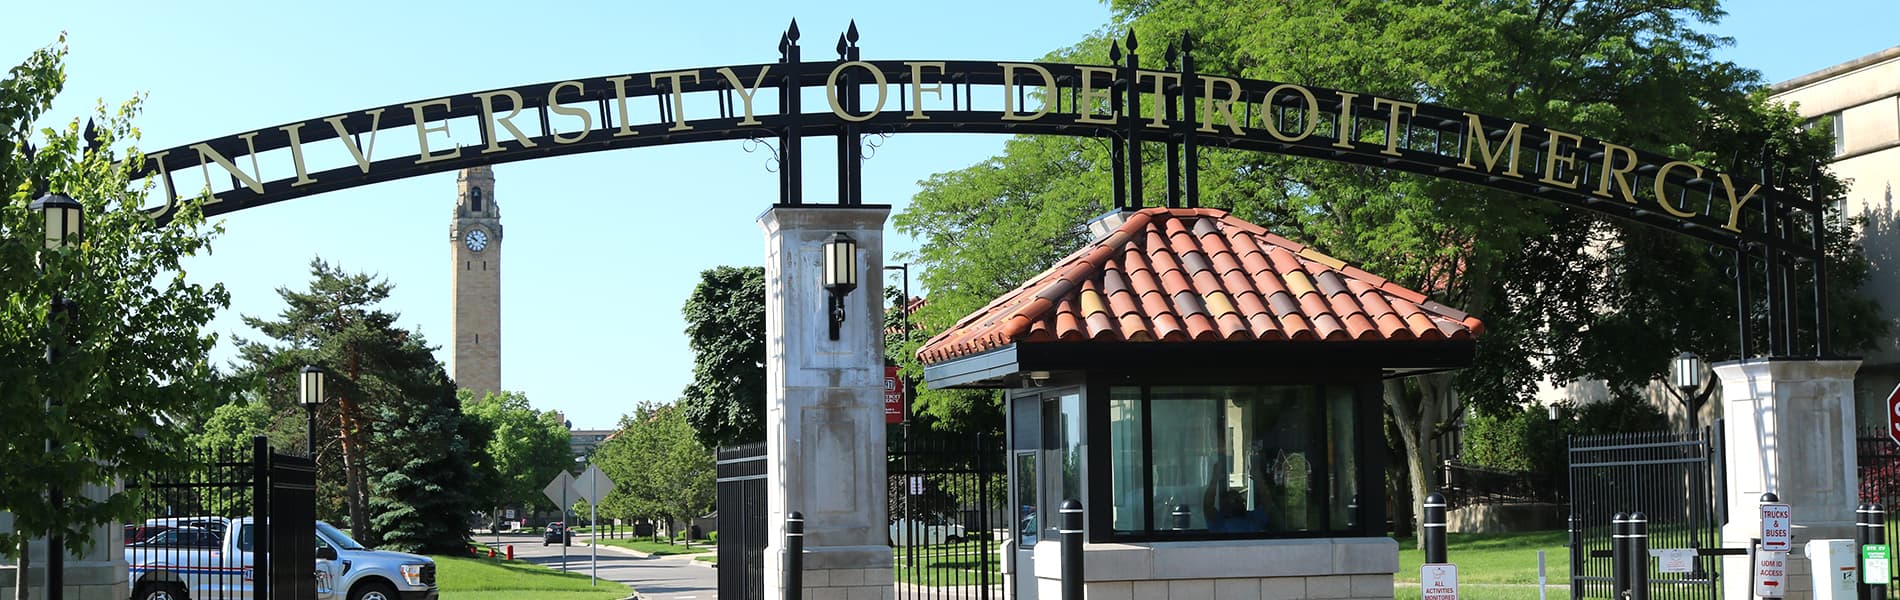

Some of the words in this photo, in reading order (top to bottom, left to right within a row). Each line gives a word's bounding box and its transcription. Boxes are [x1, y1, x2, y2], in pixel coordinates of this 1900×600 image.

[110, 65, 771, 221] UNIVERSITY
[826, 61, 946, 122] OF
[997, 62, 1418, 157] DETROIT
[1457, 111, 1762, 233] MERCY
[1764, 510, 1789, 519] TRUCKS
[1773, 520, 1779, 528] &
[1765, 529, 1787, 537] BUSES
[1760, 569, 1783, 577] ACCESS
